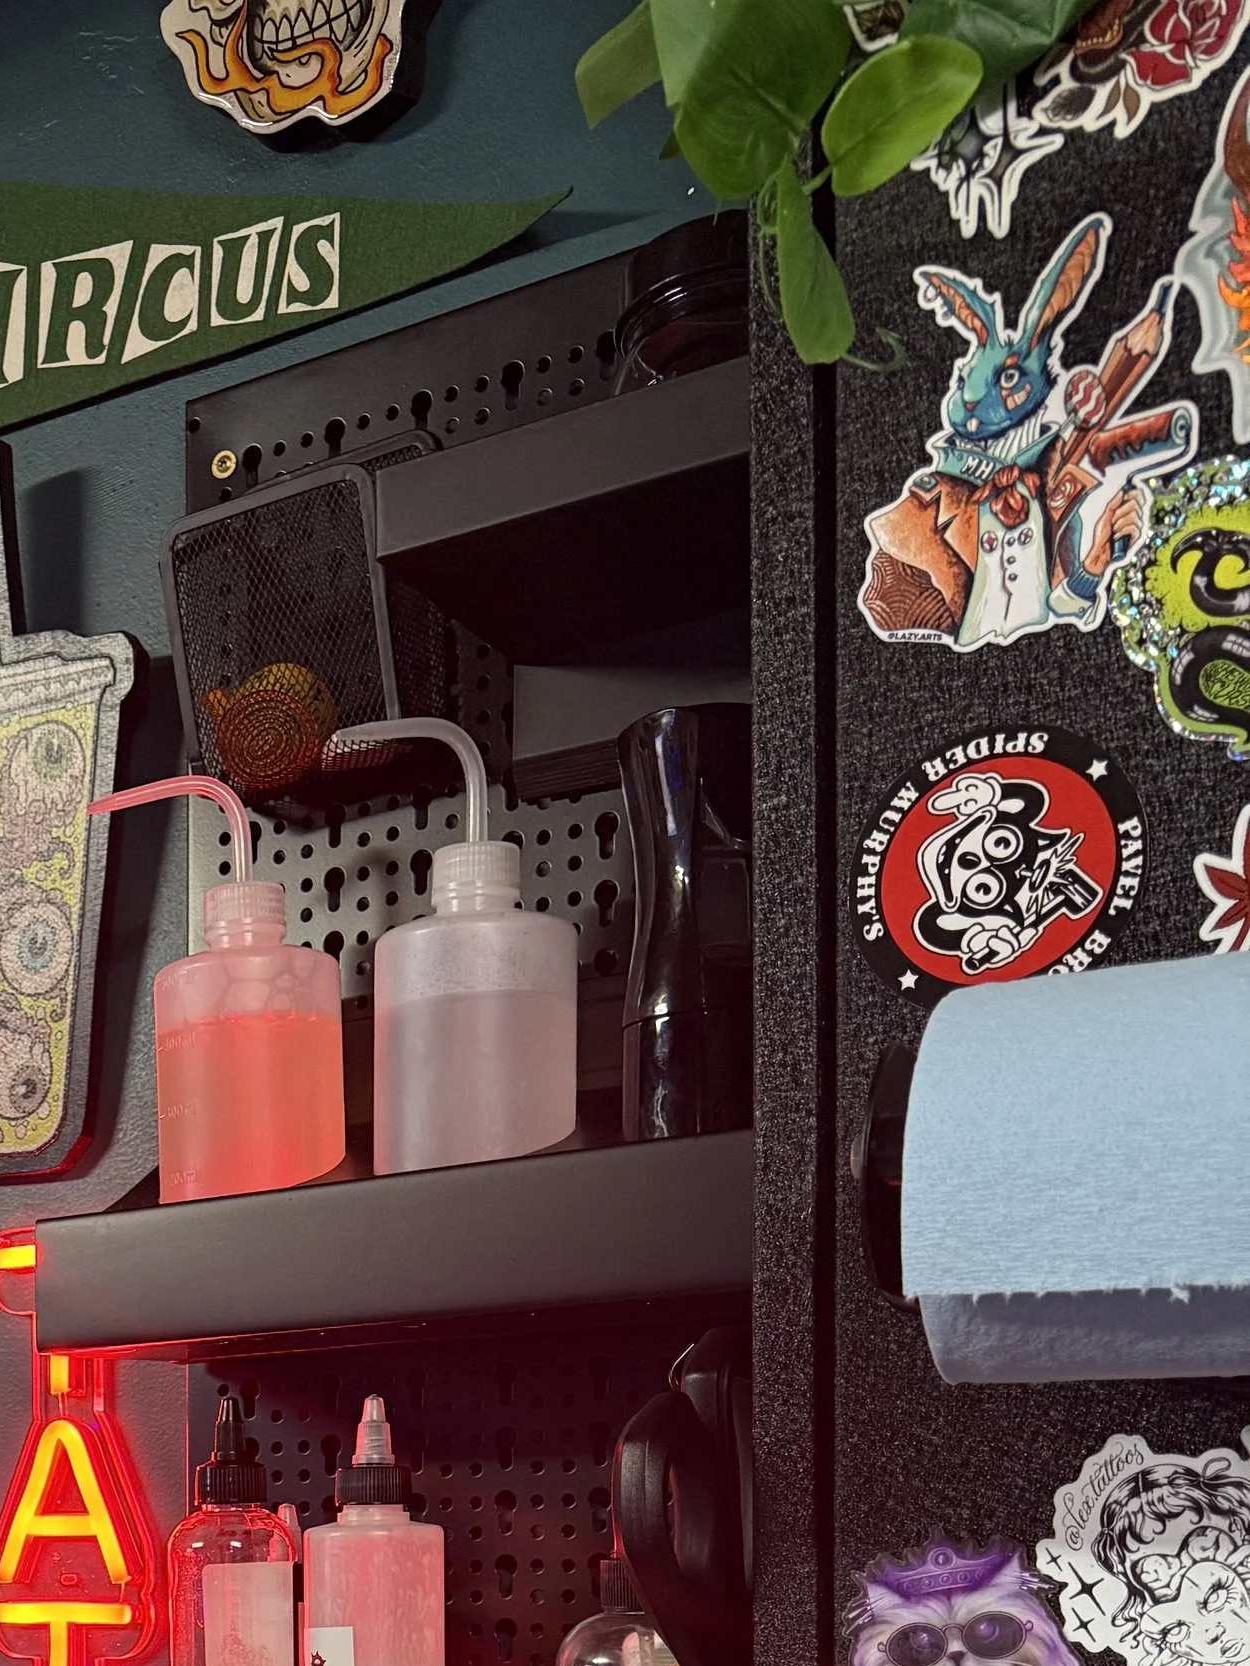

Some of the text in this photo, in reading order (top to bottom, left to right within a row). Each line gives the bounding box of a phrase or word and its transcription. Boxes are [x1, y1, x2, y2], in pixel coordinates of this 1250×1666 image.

[960, 455, 995, 481] MH
[856, 732, 1049, 941] SPIDER MURPHY'S
[1108, 816, 1143, 916] PAVEL
